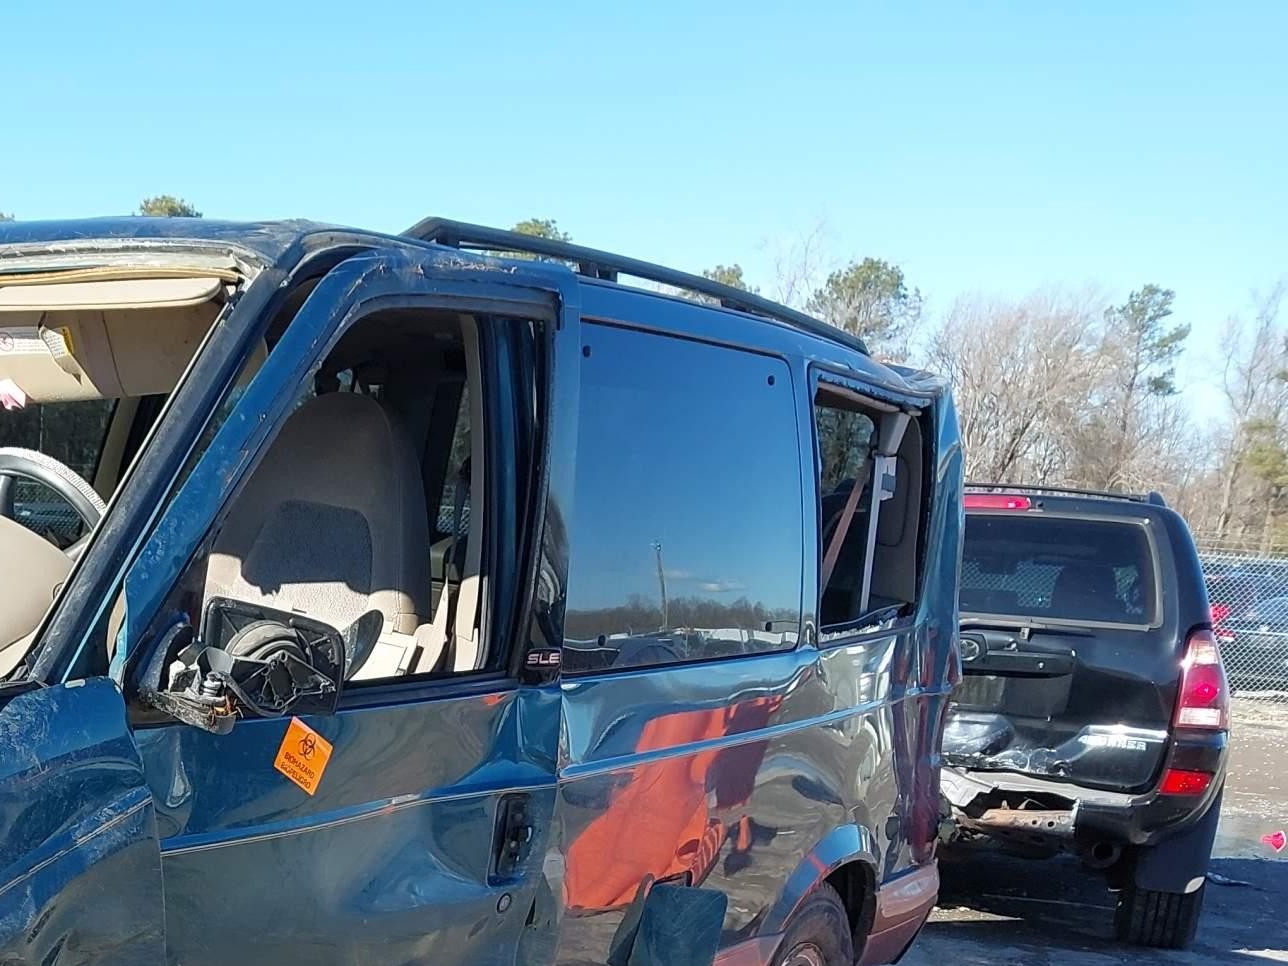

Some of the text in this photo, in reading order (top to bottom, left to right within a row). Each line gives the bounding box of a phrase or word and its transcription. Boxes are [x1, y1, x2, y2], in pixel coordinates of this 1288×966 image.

[527, 652, 560, 664] SLE
[1078, 734, 1147, 751] 4NNER
[280, 761, 311, 789] BIOPELIGRO
[284, 751, 315, 779] BIOHAZARD
